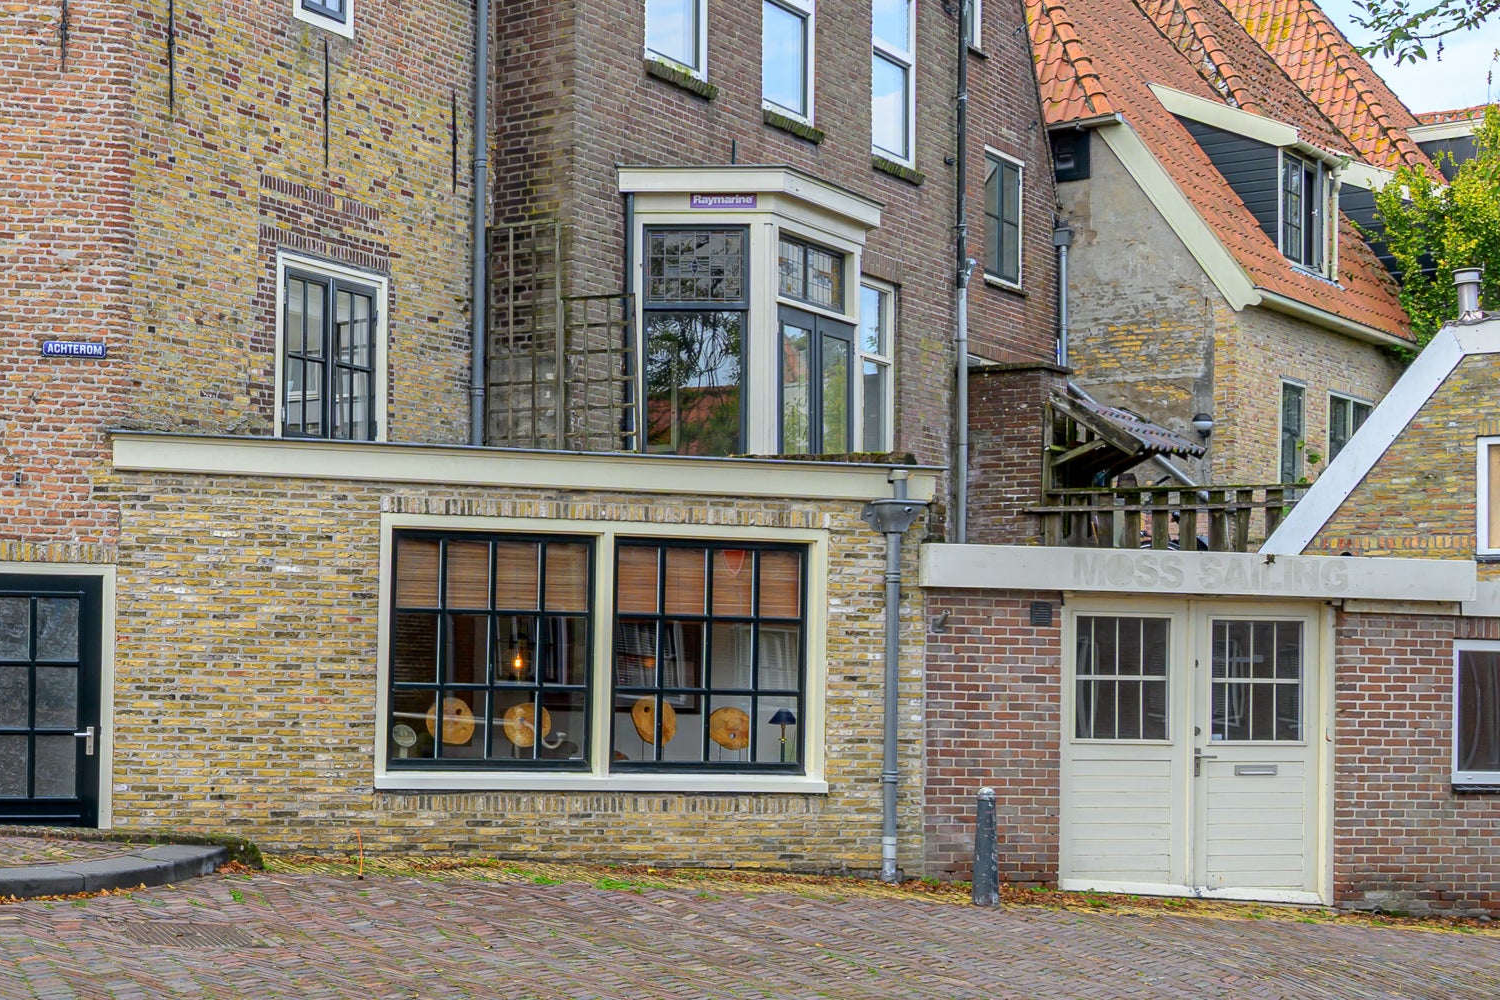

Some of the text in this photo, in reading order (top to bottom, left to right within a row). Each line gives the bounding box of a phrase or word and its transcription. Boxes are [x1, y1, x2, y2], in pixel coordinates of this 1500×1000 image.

[693, 194, 753, 206] Raymarine
[47, 343, 103, 356] ACHTEROM
[1072, 553, 1349, 593] MOSS SAILING
